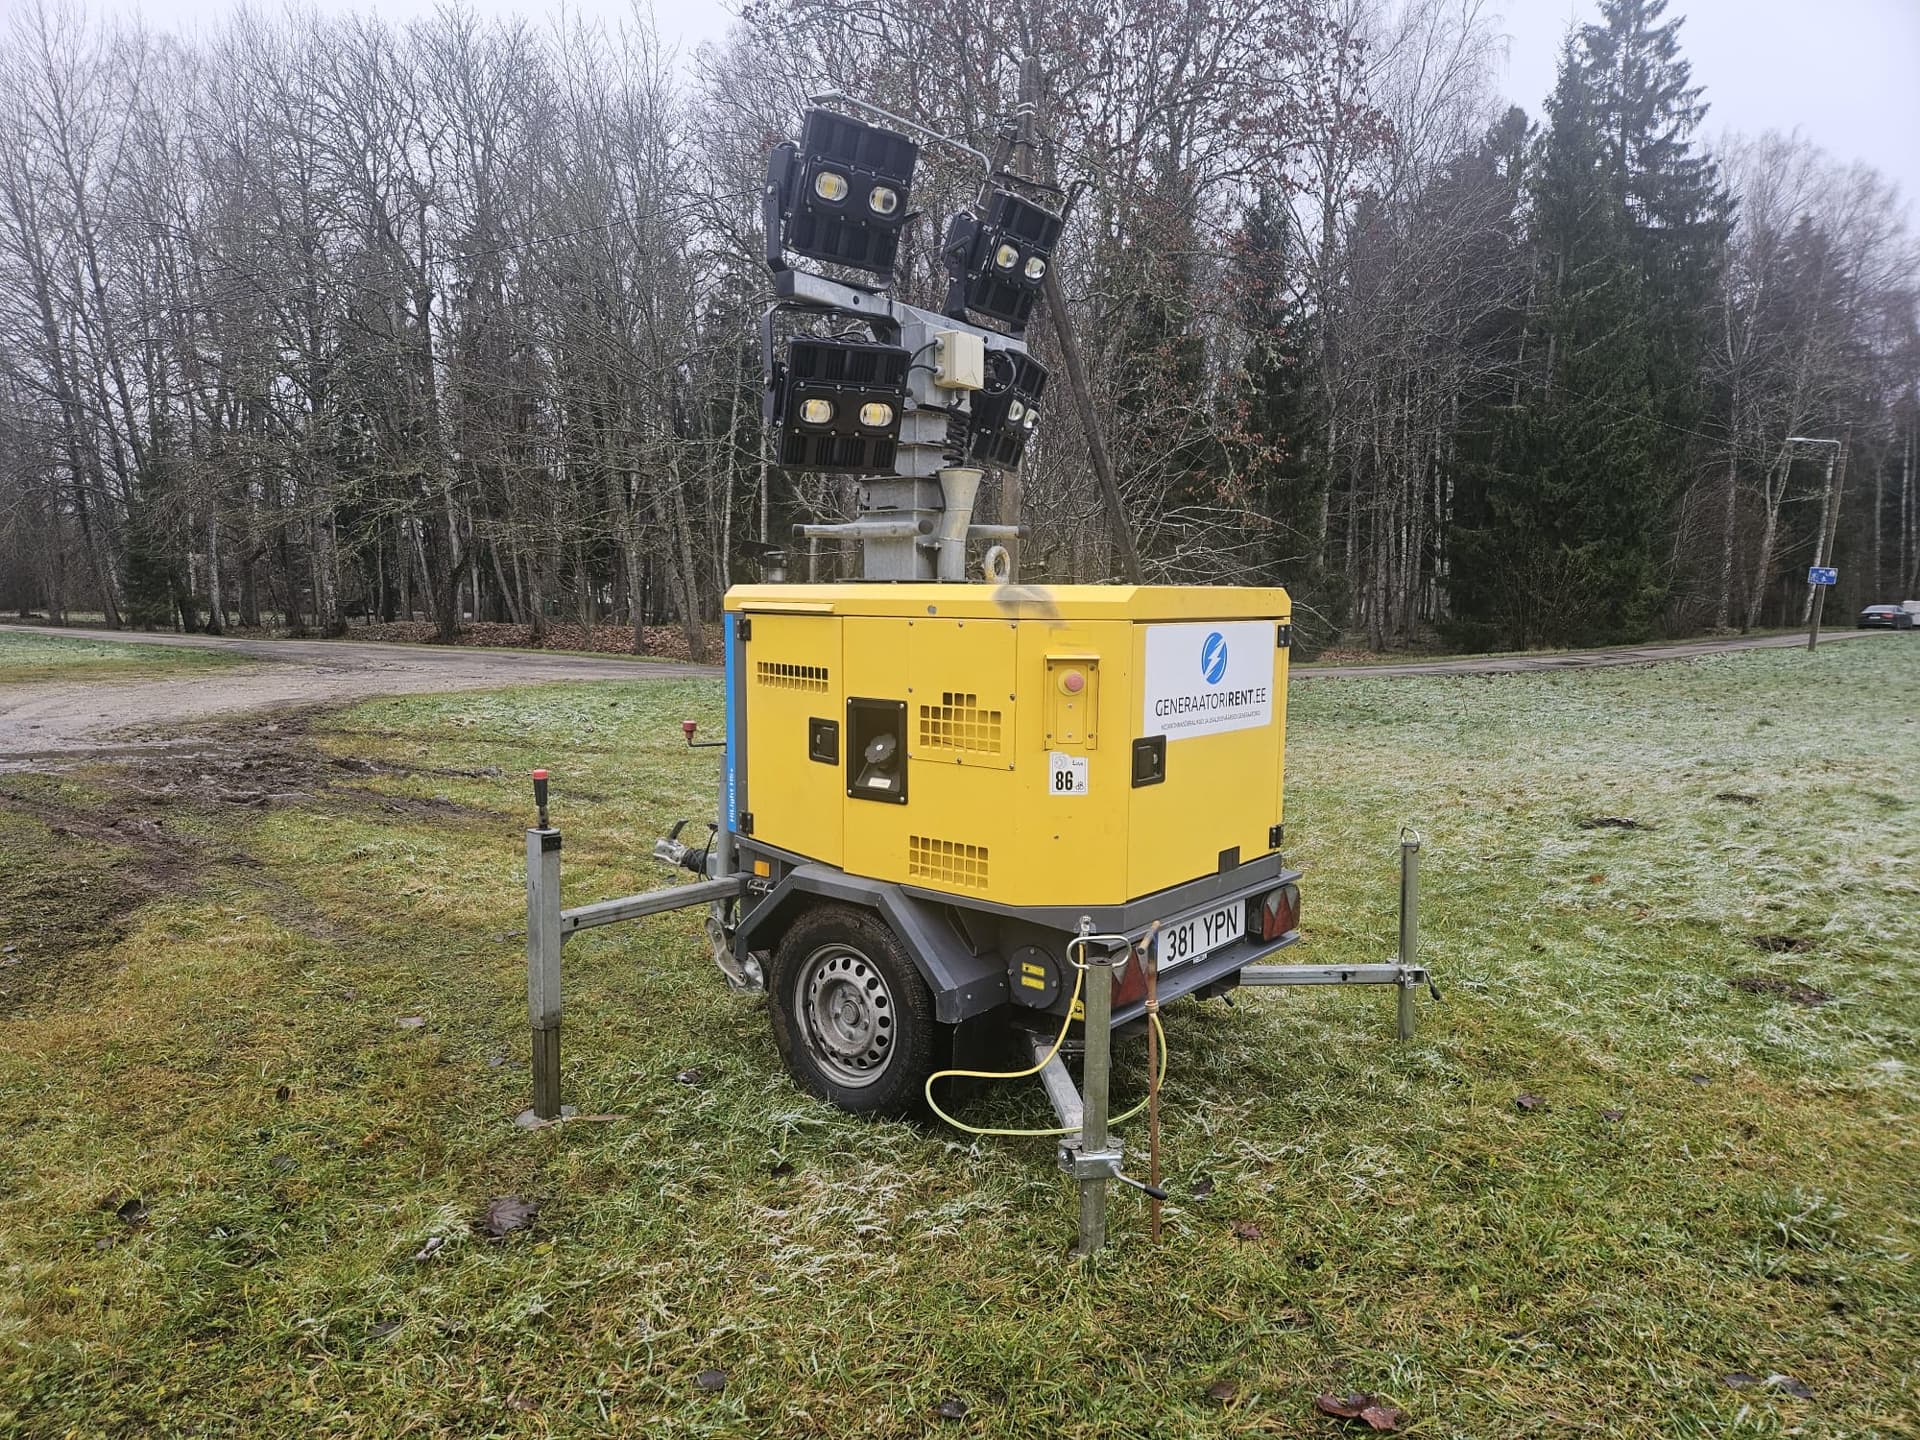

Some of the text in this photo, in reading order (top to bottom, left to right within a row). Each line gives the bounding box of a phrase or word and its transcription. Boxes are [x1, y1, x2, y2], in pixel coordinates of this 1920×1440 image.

[1155, 688, 1267, 717] GENERAATORIRENT.EE
[1055, 770, 1073, 791] 86
[1167, 906, 1238, 962] 381 YPN
